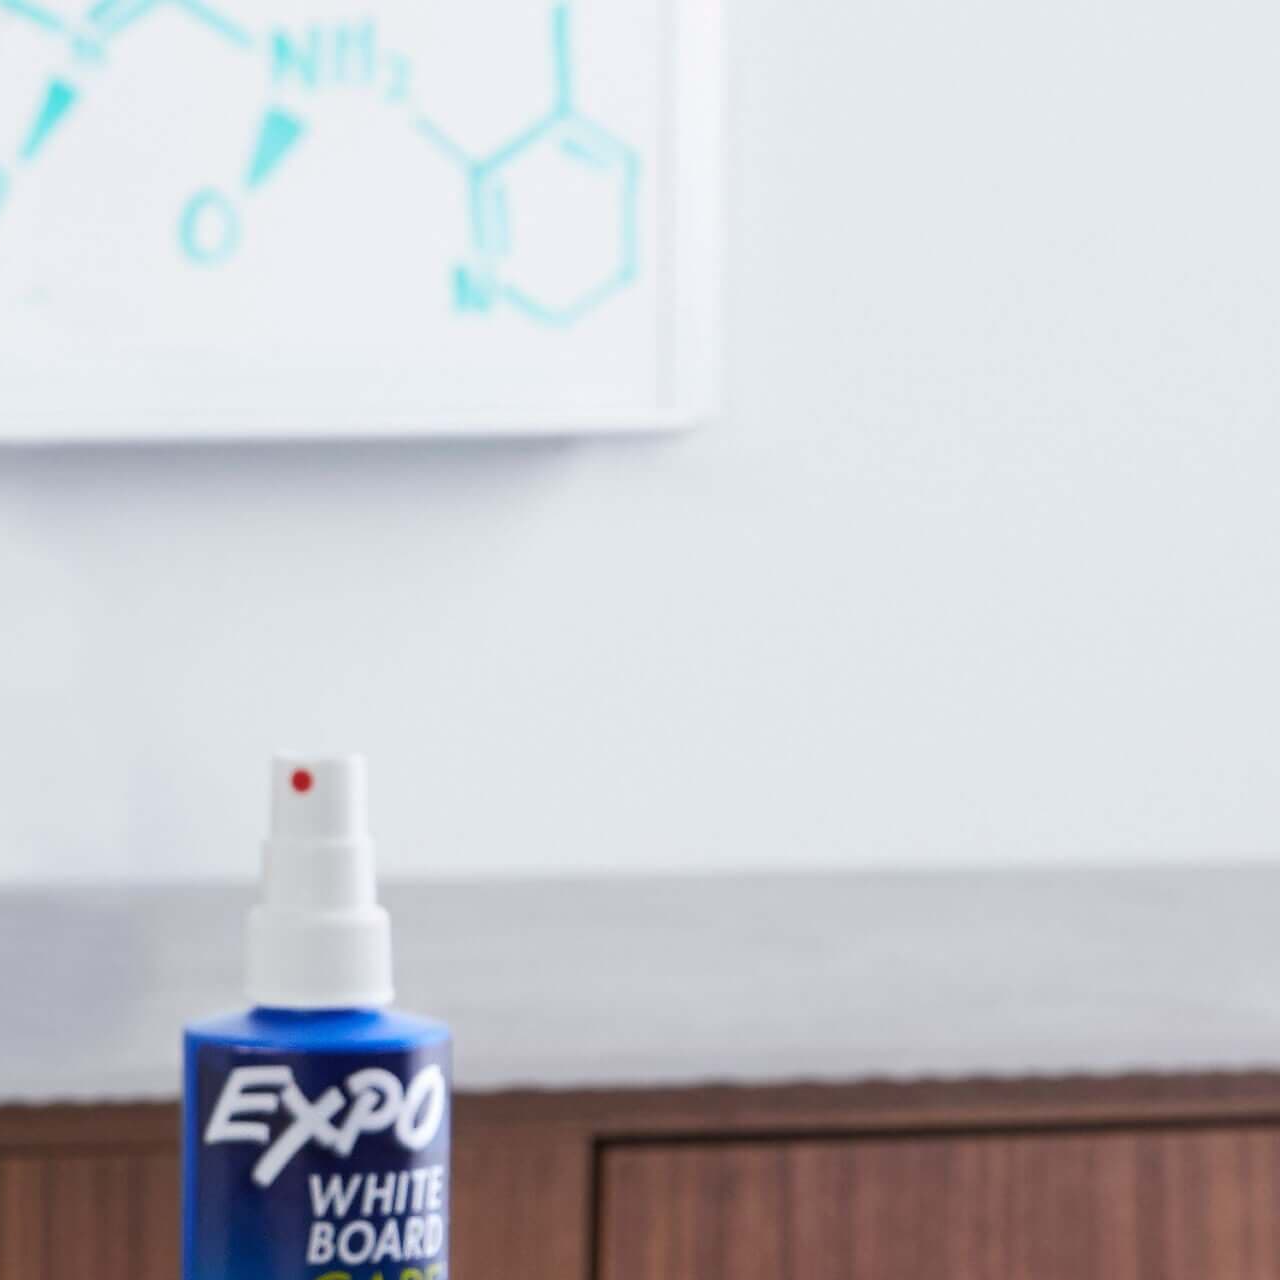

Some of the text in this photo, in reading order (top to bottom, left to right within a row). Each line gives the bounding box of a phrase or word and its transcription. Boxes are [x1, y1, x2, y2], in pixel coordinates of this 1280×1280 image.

[203, 1064, 446, 1187] EXPO
[308, 1166, 443, 1218] WHITE
[306, 1213, 443, 1266] BOARD
